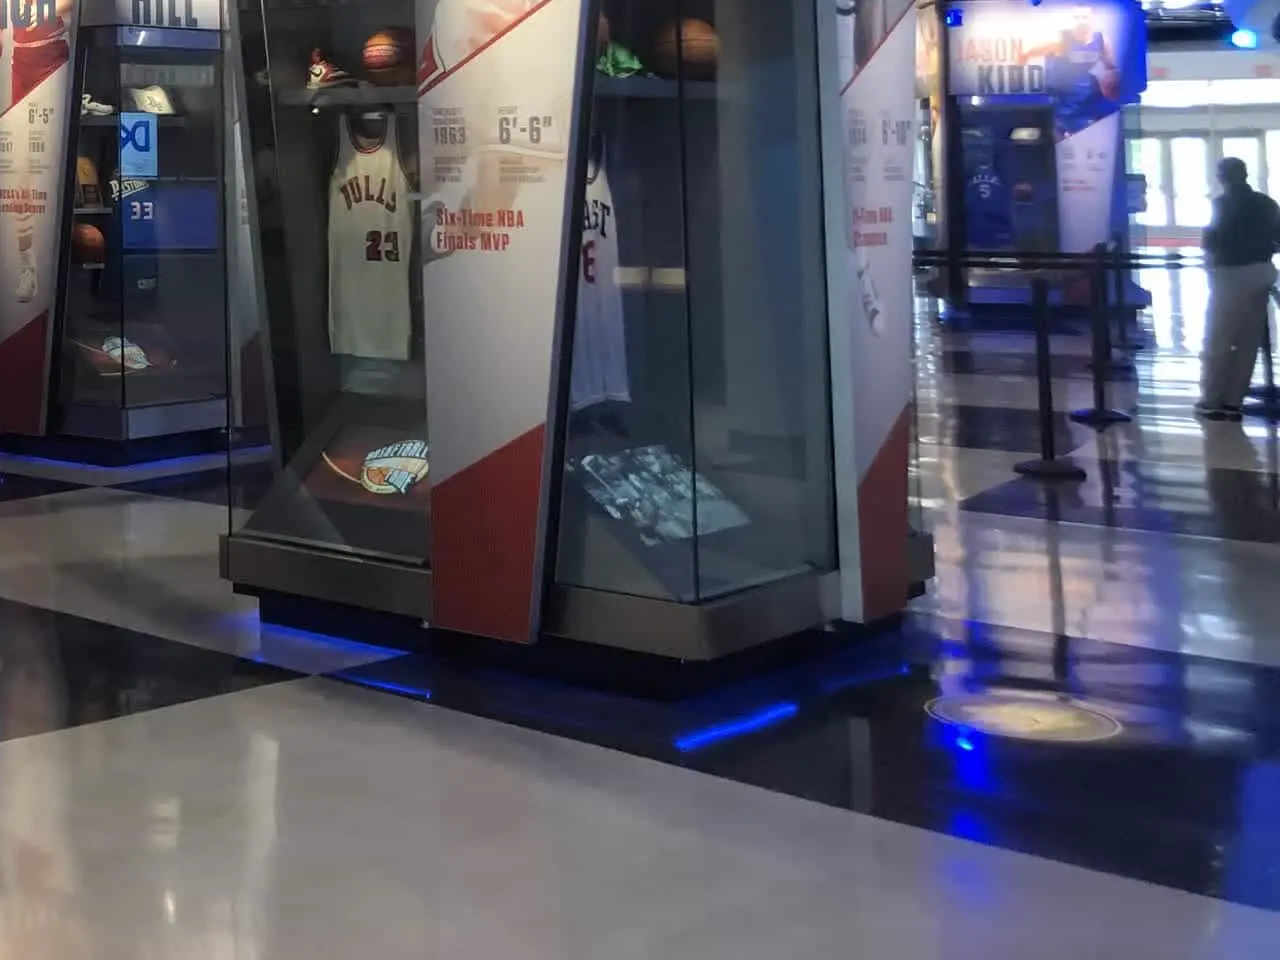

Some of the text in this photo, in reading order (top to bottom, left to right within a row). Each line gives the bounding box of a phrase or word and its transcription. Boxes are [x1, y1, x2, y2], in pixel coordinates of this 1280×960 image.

[130, 201, 154, 220] 33
[496, 209, 525, 228] NBA
[365, 230, 400, 262] 23
[436, 231, 510, 252] Finals MVP
